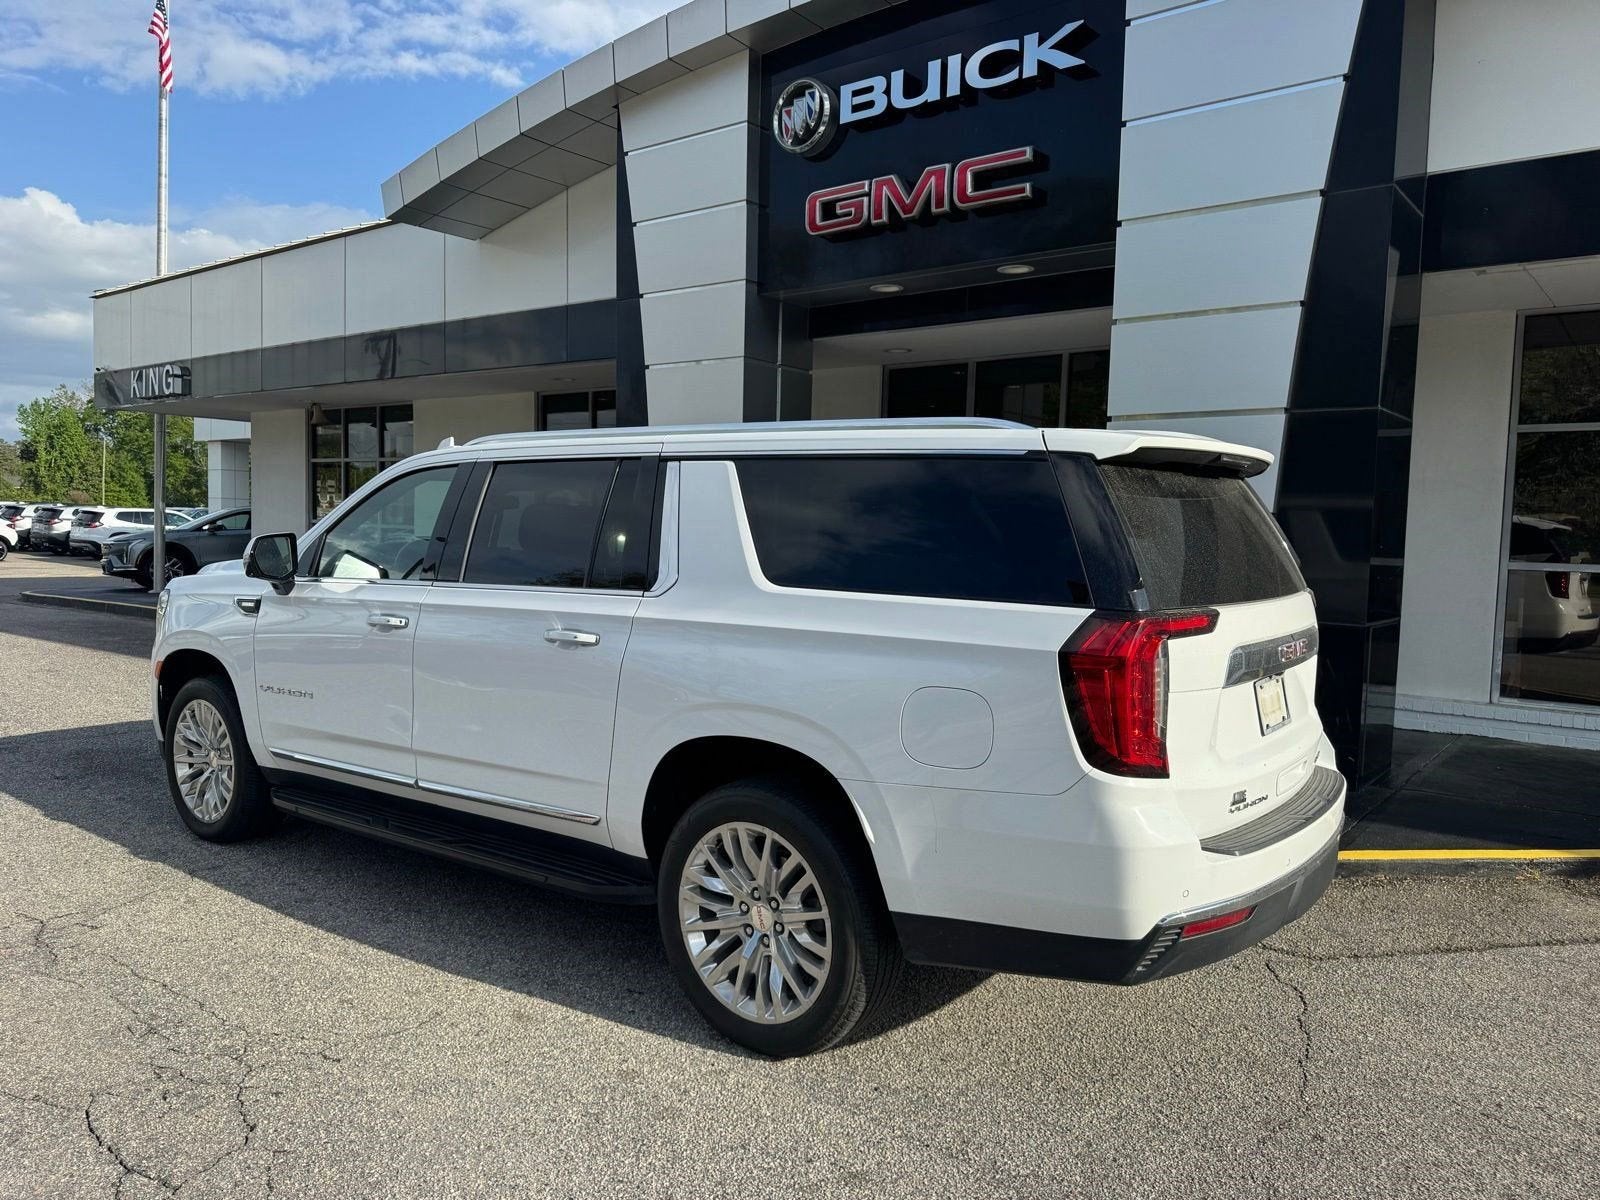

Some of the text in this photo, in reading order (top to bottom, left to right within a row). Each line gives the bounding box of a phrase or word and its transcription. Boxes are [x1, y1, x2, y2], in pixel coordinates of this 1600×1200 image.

[839, 19, 1085, 125] BUICK
[805, 145, 1033, 236] GMC
[130, 364, 173, 398] KING
[1279, 639, 1308, 661] GMC
[259, 685, 314, 699] YUKON
[1228, 794, 1268, 813] YUKON
